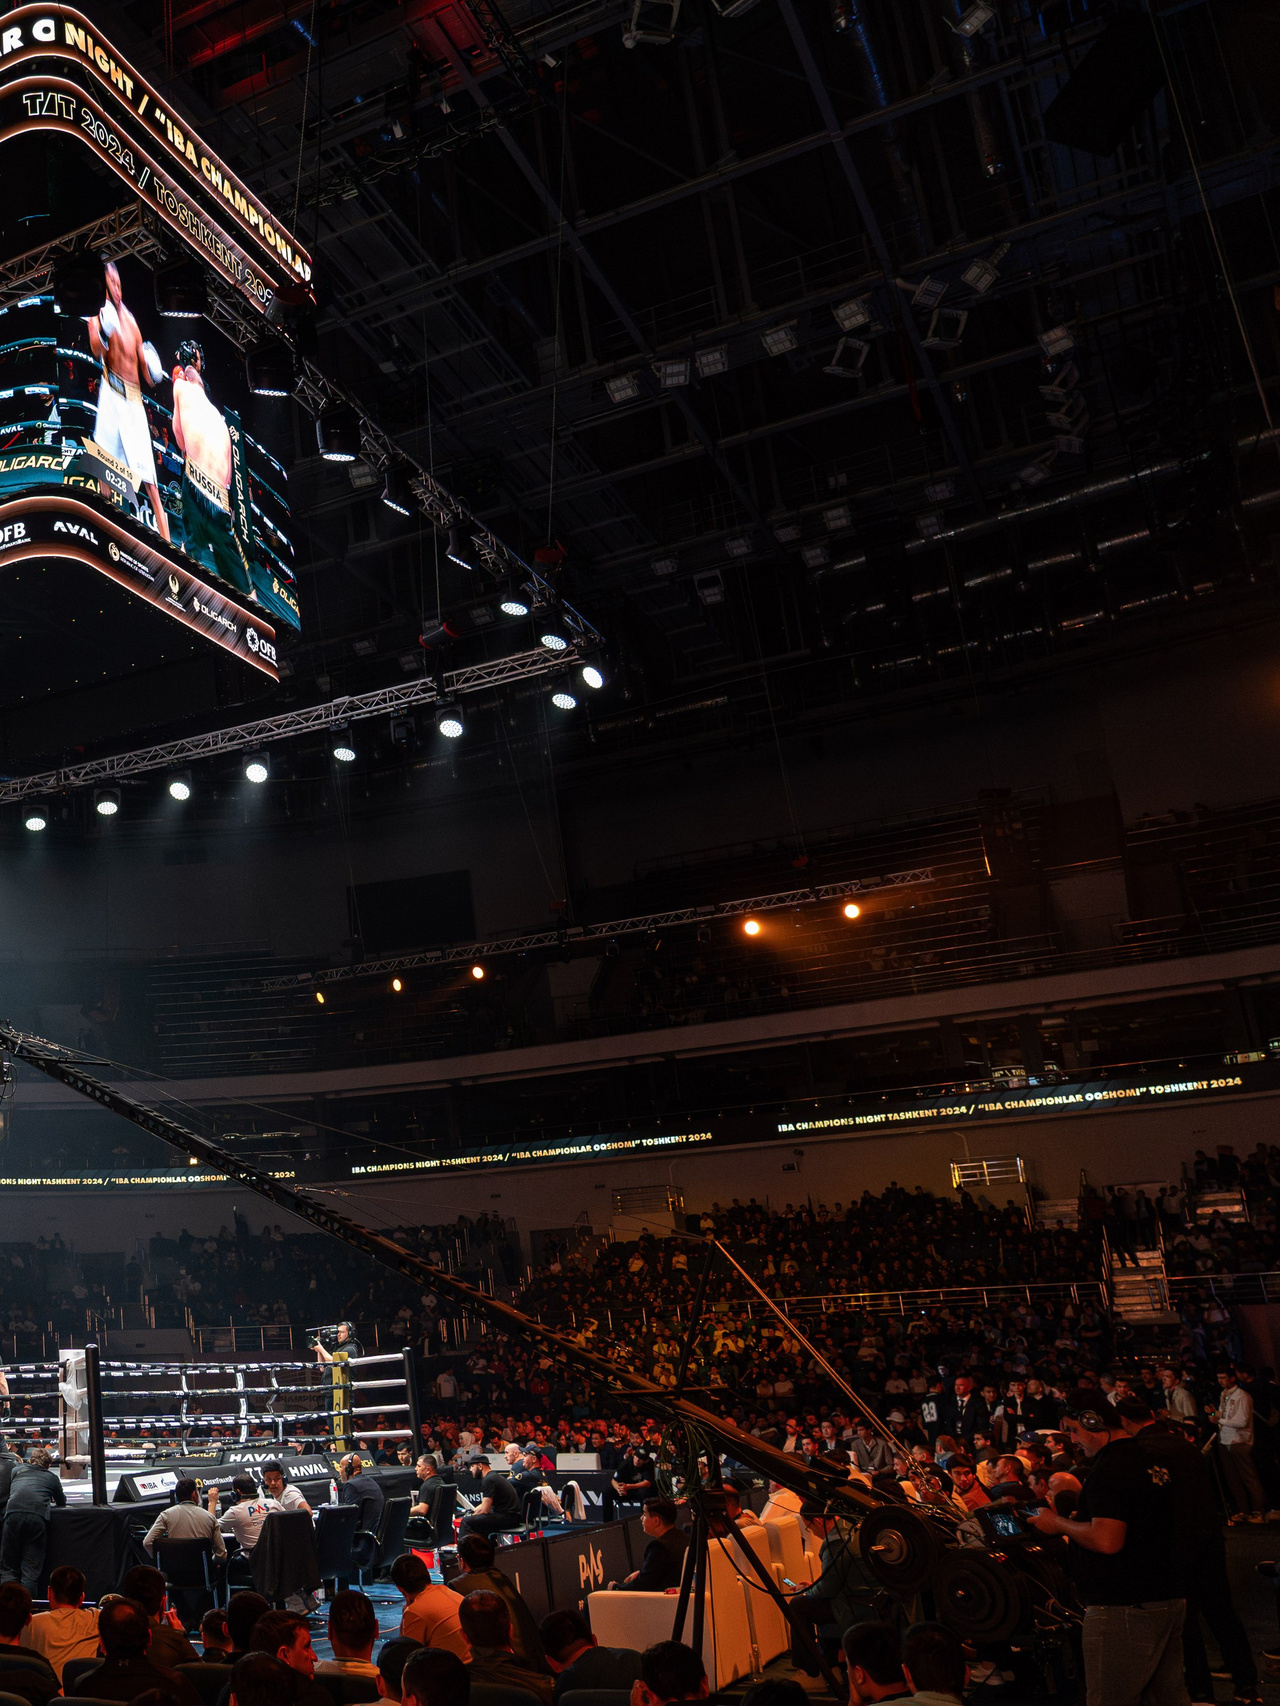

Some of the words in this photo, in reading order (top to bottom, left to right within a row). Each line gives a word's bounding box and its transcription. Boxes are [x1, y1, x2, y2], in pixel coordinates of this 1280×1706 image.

[64, 22, 134, 100] NIGHT
[81, 107, 136, 176] 2024
[153, 176, 243, 281] TOSHKENT
[96, 449, 115, 467] Round
[115, 462, 119, 470] 2
[126, 470, 133, 480] 10
[105, 469, 127, 493] 02:28
[188, 463, 224, 504] RUSSIA
[231, 444, 250, 544] OLIGARCH
[200, 604, 237, 633] OLIGARCH
[259, 640, 277, 661] OFB
[778, 1124, 795, 1133] IBA
[796, 1118, 854, 1131] CHAMPIONS
[855, 1113, 886, 1124] NIGHT
[887, 1109, 938, 1121] TASHKENT
[939, 1106, 968, 1116] 2024
[1004, 1094, 1084, 1110] CHAMPIONLAR
[1148, 1080, 1209, 1095] TOSHKENT
[1210, 1077, 1243, 1089] 2024
[352, 1166, 366, 1174] IBA
[366, 1162, 415, 1172] CHAMPIONS
[415, 1160, 440, 1168] NIGHT
[440, 1156, 481, 1166] TASHKENT
[482, 1154, 504, 1163] 2024
[532, 1145, 592, 1157] CHAMPIONLAR
[641, 1135, 687, 1146] TOSHKENT
[688, 1132, 712, 1142] 2024
[130, 1176, 187, 1184] CHAMPIONLAR
[288, 1463, 328, 1477] HAVAL
